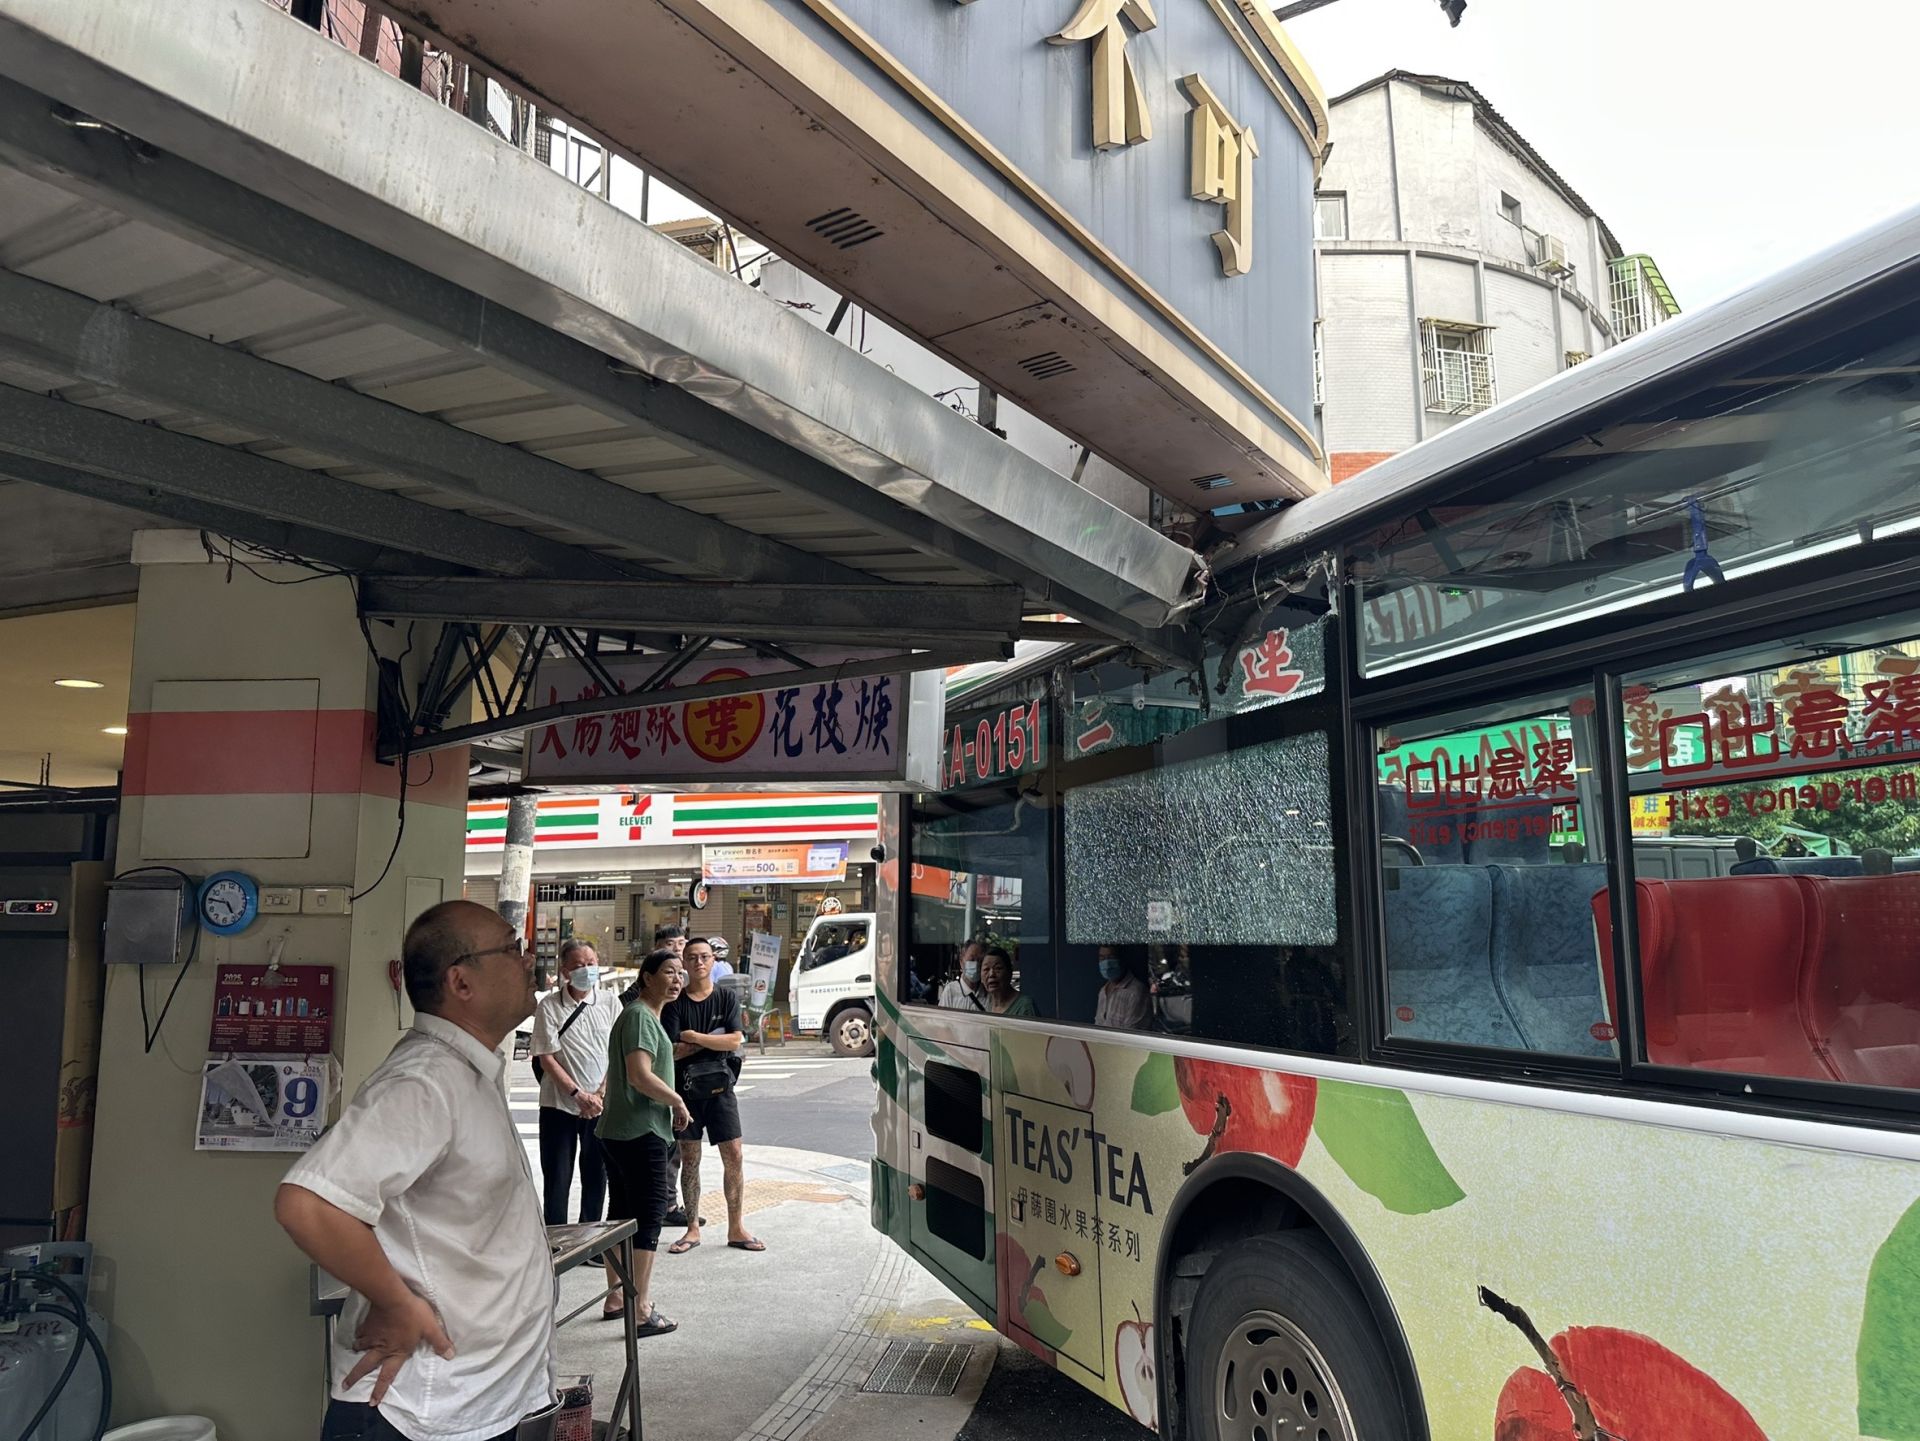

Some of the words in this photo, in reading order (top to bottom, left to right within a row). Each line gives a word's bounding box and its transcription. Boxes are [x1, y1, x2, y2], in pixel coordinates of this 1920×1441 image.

[955, 0, 1259, 278] 不可
[283, 1077, 318, 1118] 9
[1084, 1127, 1154, 1215] TEA
